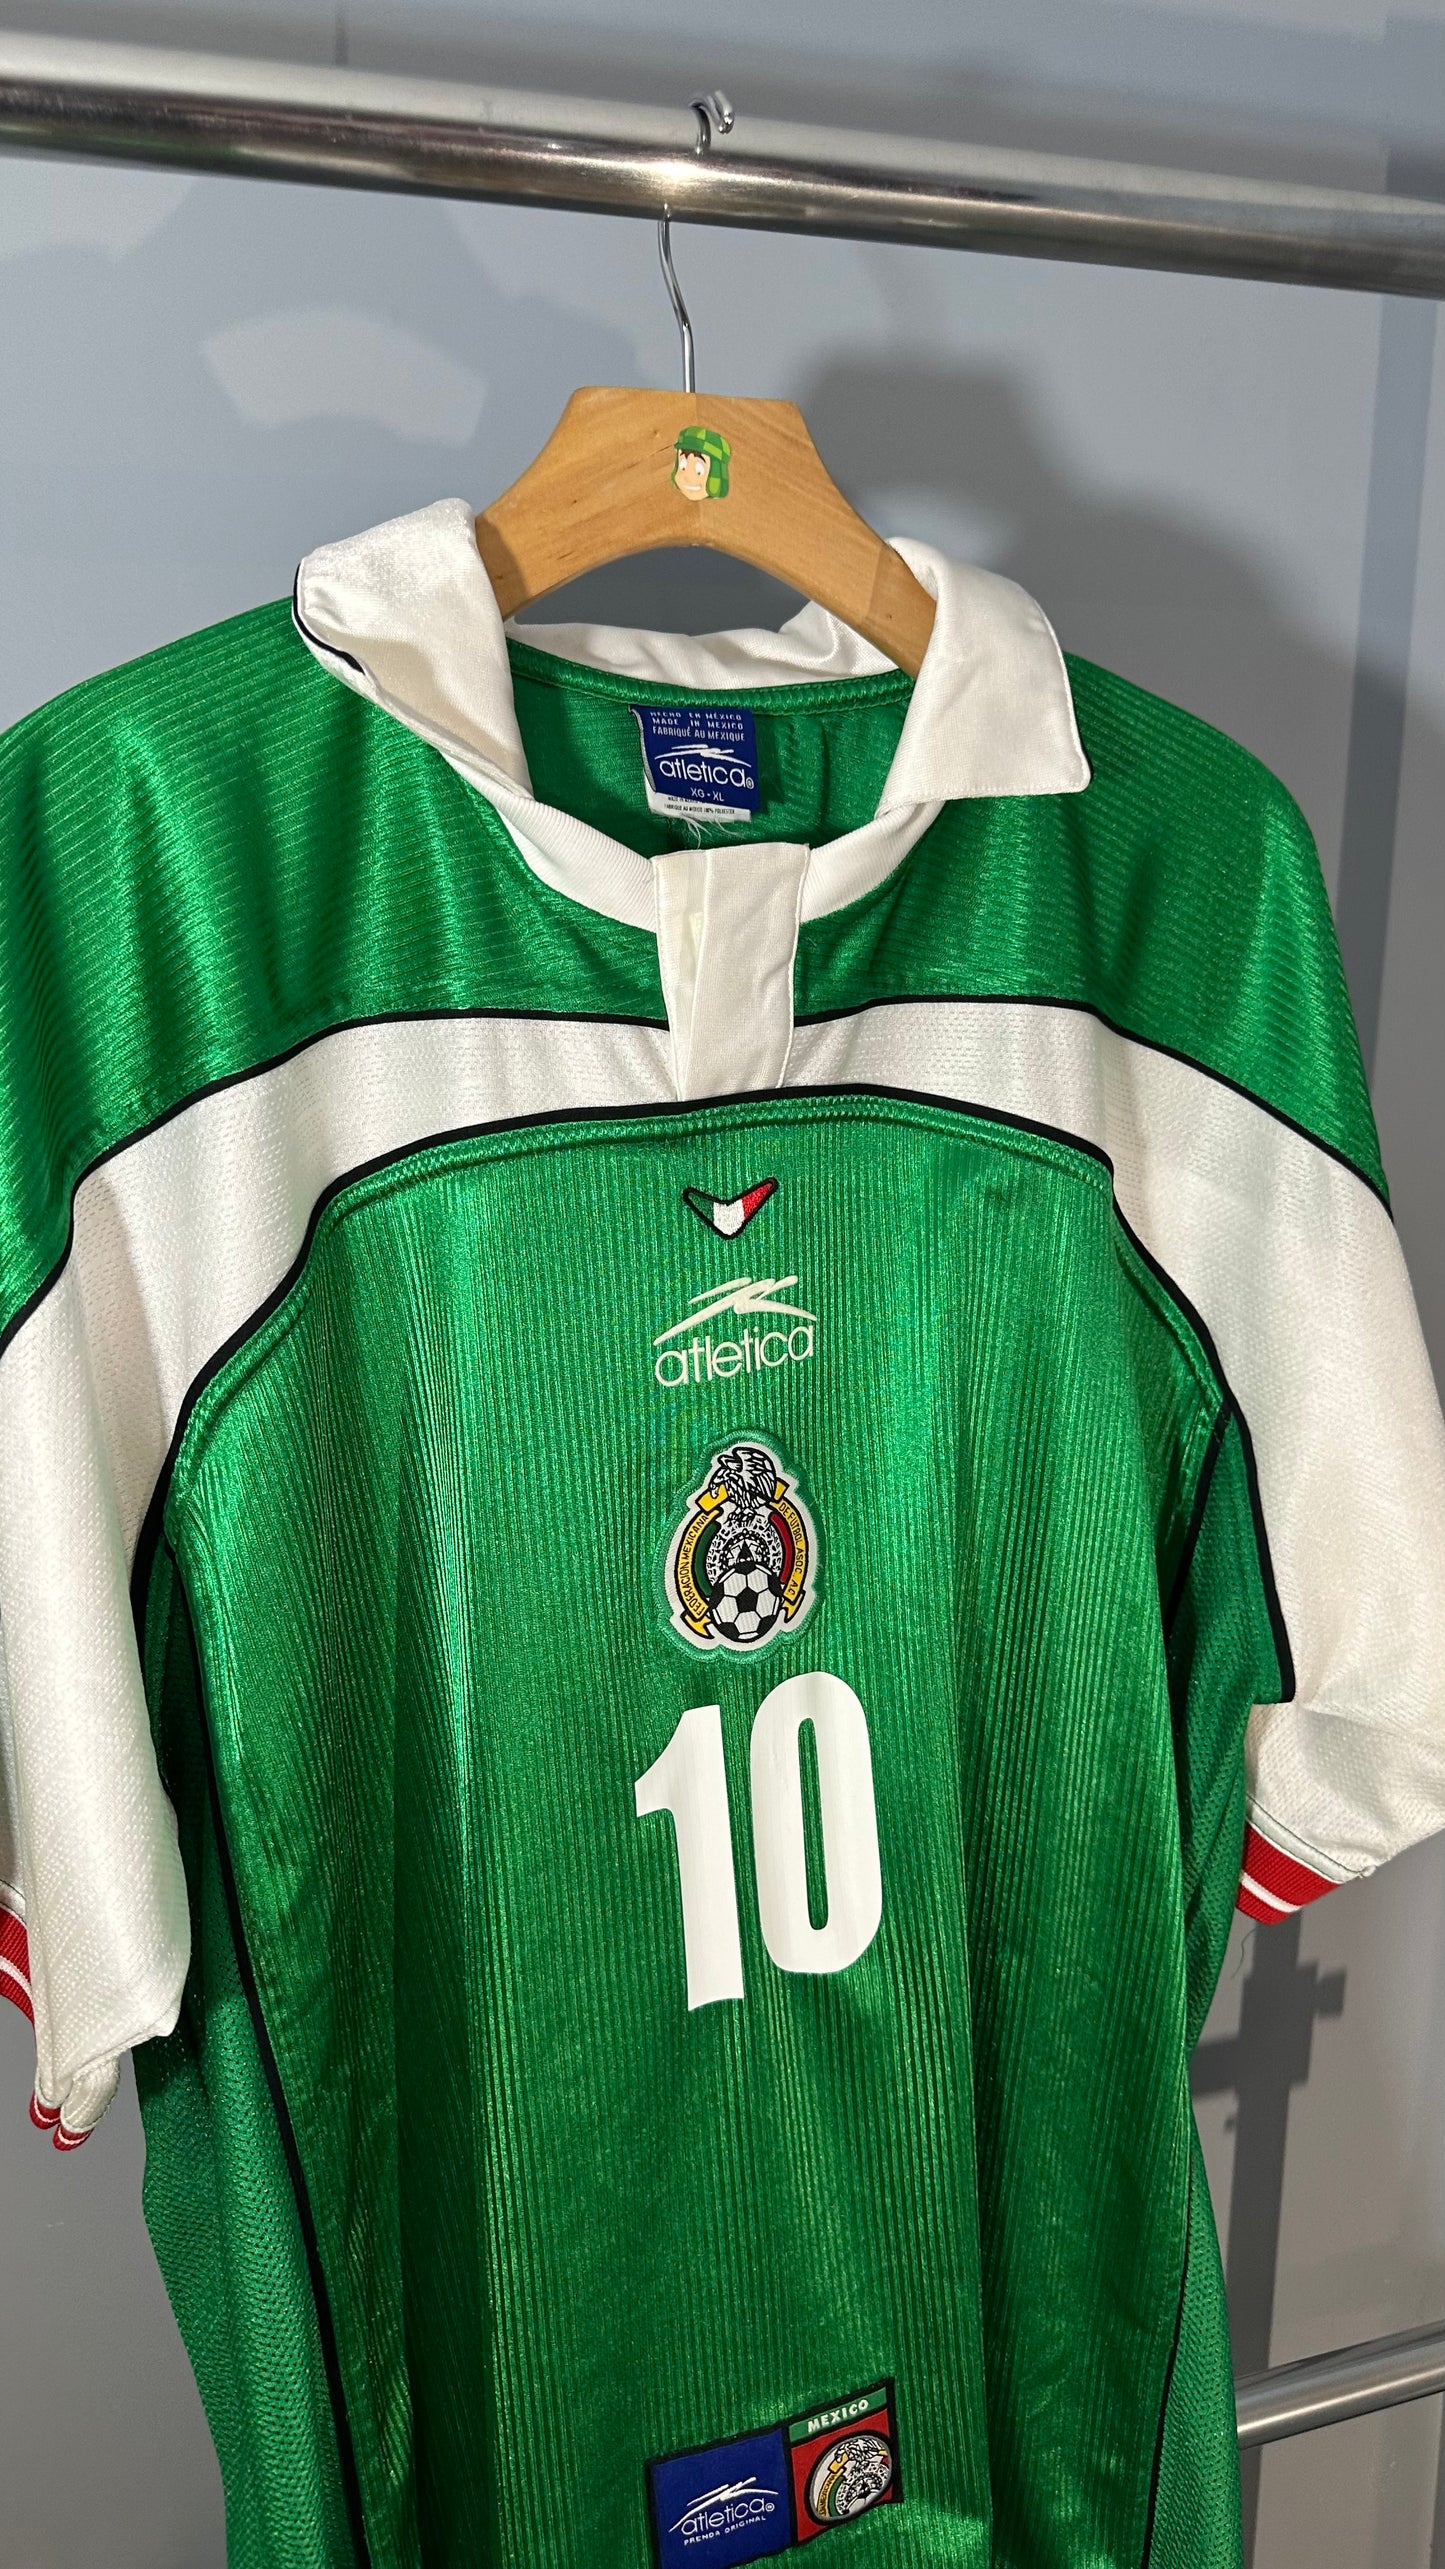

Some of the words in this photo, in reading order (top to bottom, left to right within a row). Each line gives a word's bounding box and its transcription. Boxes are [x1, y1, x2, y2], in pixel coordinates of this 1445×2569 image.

[652, 717, 679, 726] MADE
[707, 721, 744, 730] MEXICO
[652, 726, 692, 738] FABRIQUÉ
[694, 729, 706, 739] AU
[707, 730, 745, 742] MEXIQUE
[690, 787, 706, 799] XG
[712, 790, 725, 802] XL
[655, 1325, 814, 1387] atletica
[681, 1514, 709, 1561] MEXICANA
[779, 1502, 790, 1517] DE
[788, 1512, 803, 1546] FUTBOL
[679, 1561, 706, 1616] FEDERACION
[634, 1671, 883, 2012] 10
[807, 2399, 869, 2434] MEXICO
[684, 2530, 721, 2546] PRENDA
[724, 2515, 767, 2534] ORIGINAL
